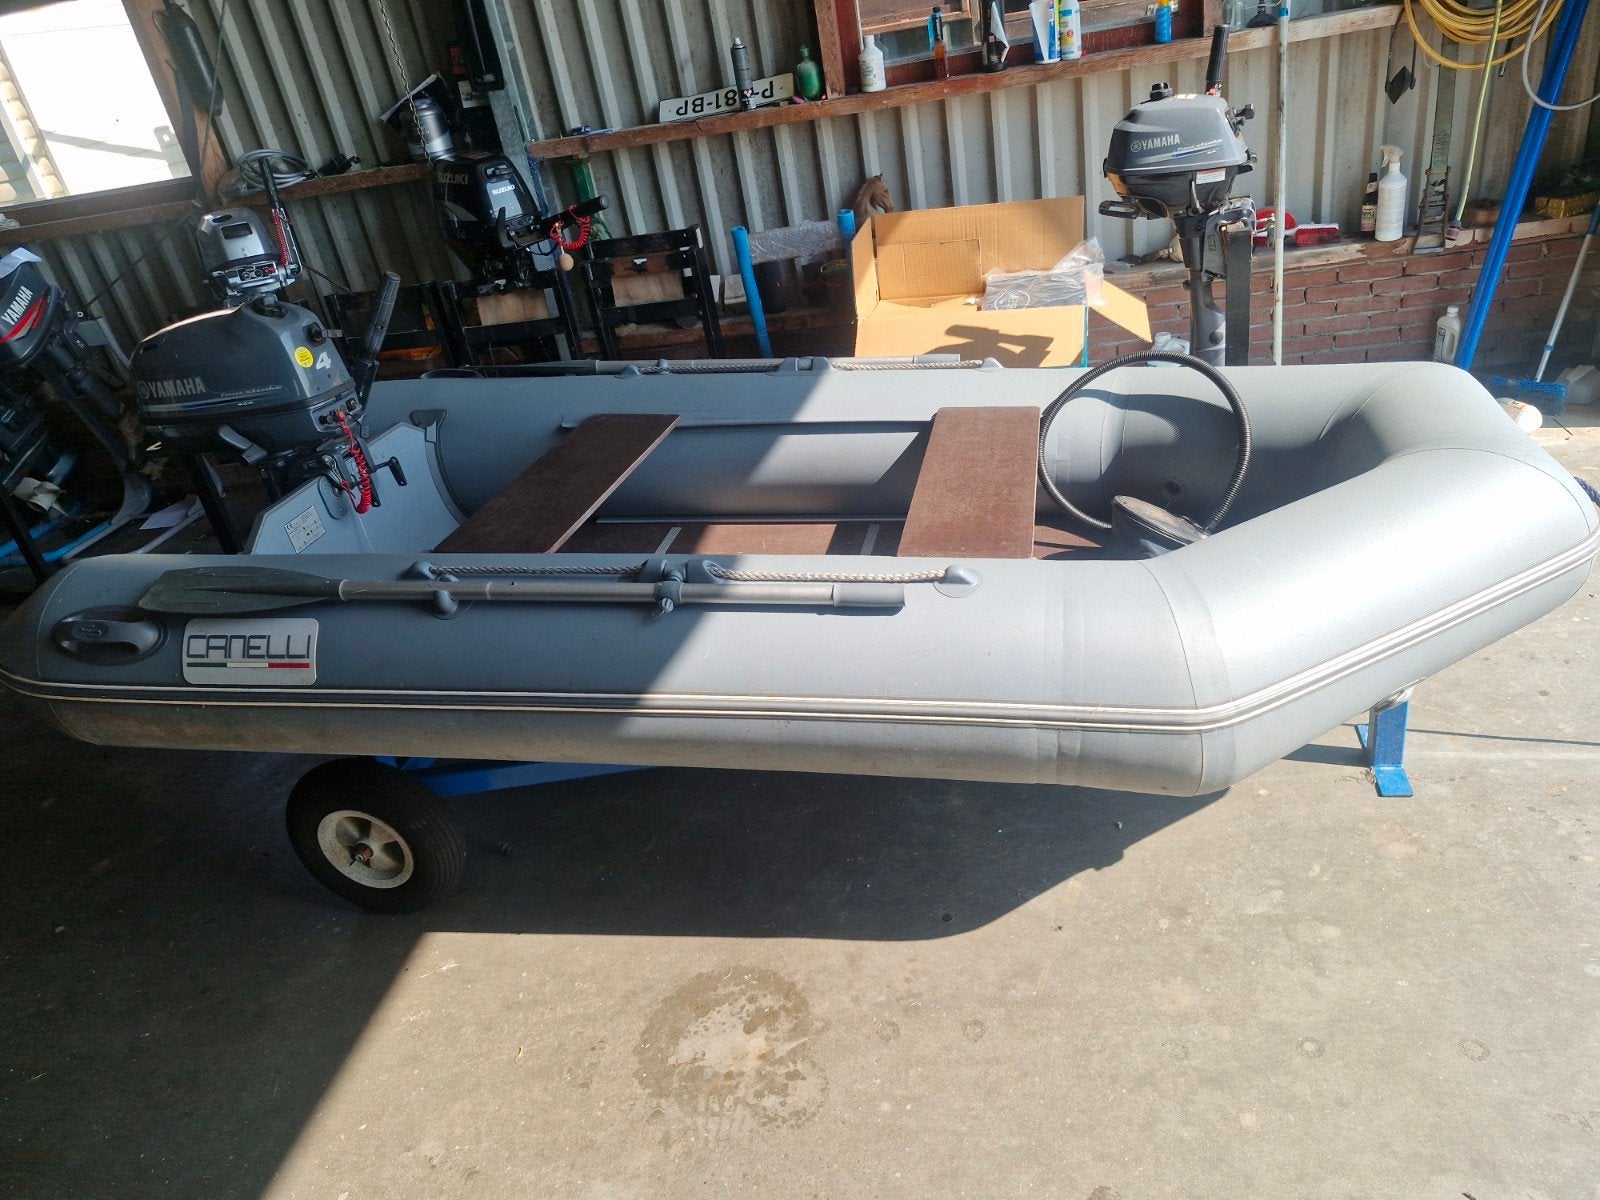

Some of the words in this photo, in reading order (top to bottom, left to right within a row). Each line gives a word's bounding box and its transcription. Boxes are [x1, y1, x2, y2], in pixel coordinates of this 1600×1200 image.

[675, 80, 775, 117] P-81-BP
[1142, 133, 1181, 151] YAMAHA
[437, 172, 469, 186] SUZUKI
[491, 184, 516, 195] SUZUKI
[1, 285, 34, 326] YAMAHA
[315, 351, 332, 370] 4
[150, 376, 208, 400] YAMAHA
[186, 634, 312, 659] CANELLI
